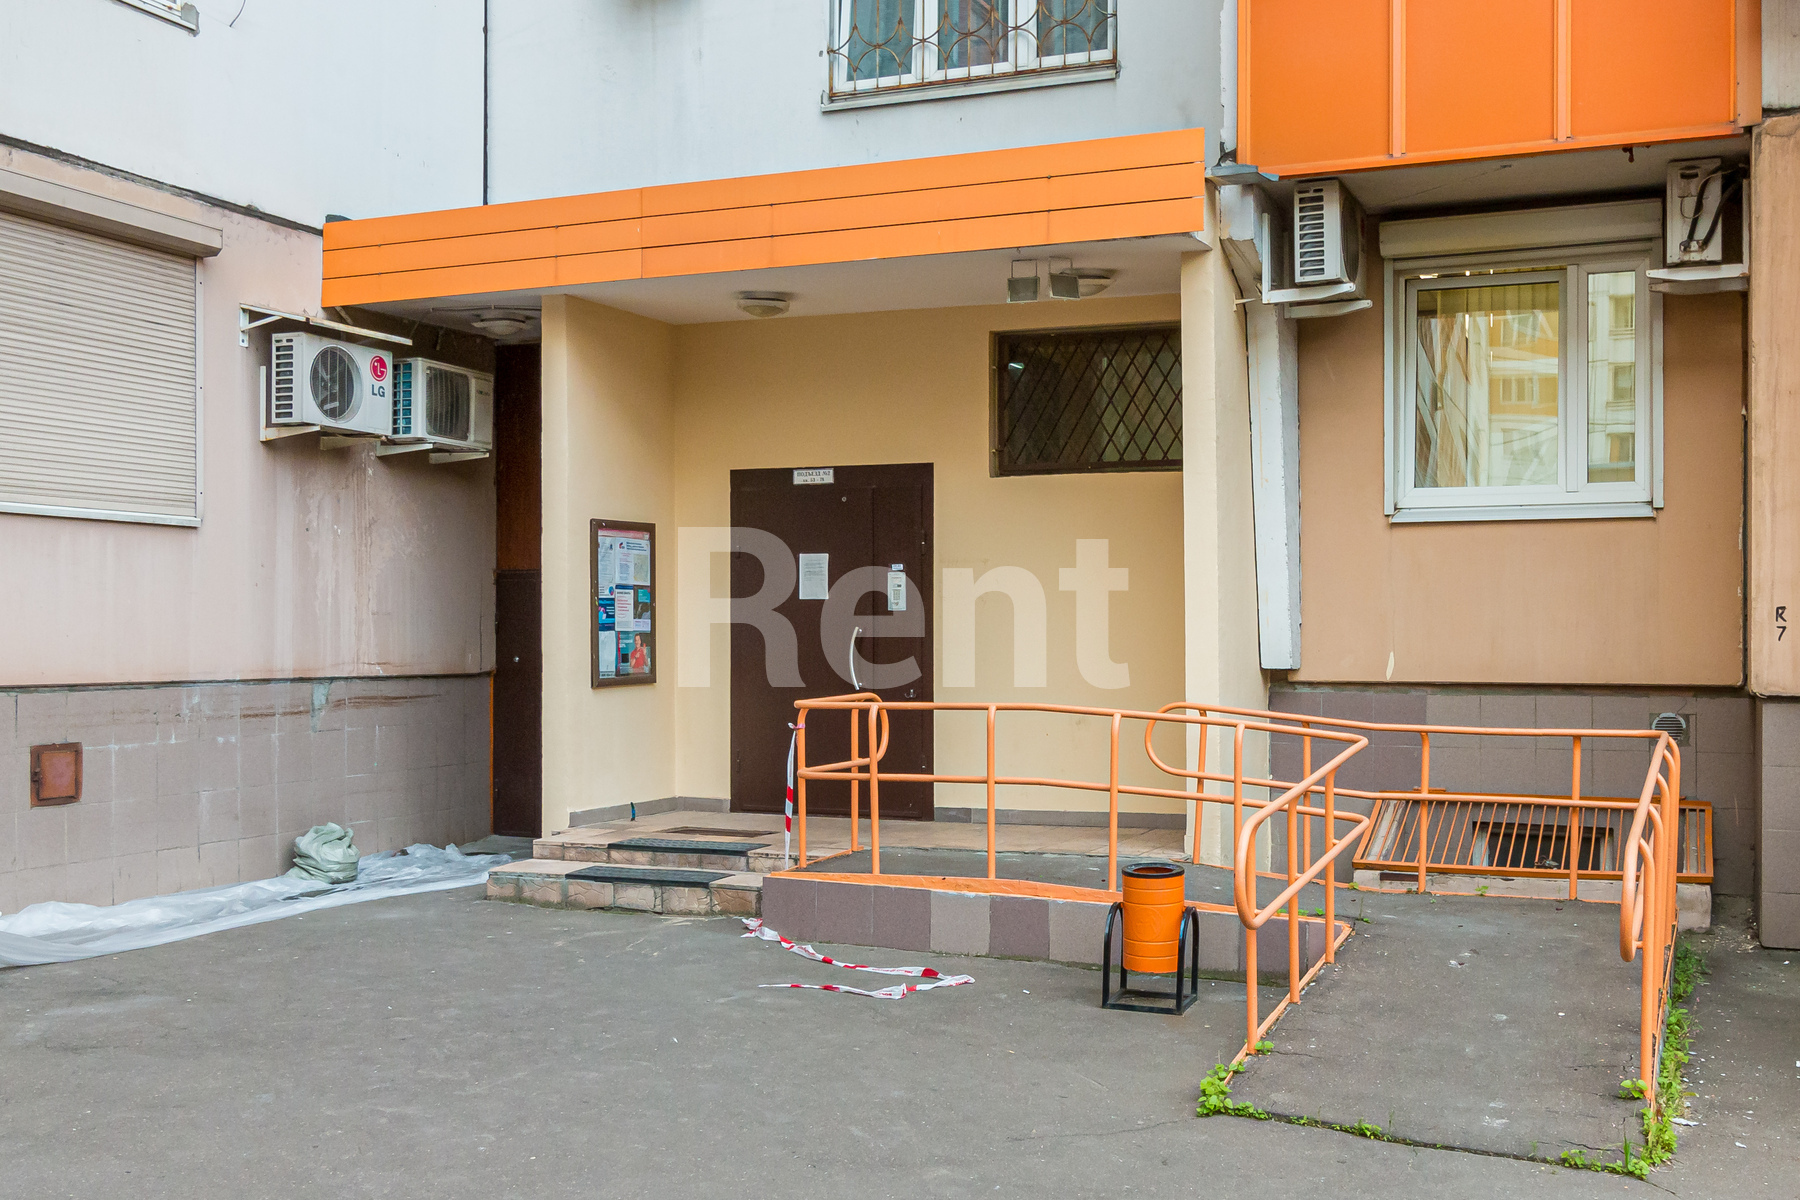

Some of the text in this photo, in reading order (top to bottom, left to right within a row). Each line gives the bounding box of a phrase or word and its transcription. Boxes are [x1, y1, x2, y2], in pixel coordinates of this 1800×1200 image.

[372, 384, 386, 398] LG
[1776, 606, 1787, 622] R
[1776, 626, 1786, 641] 7
